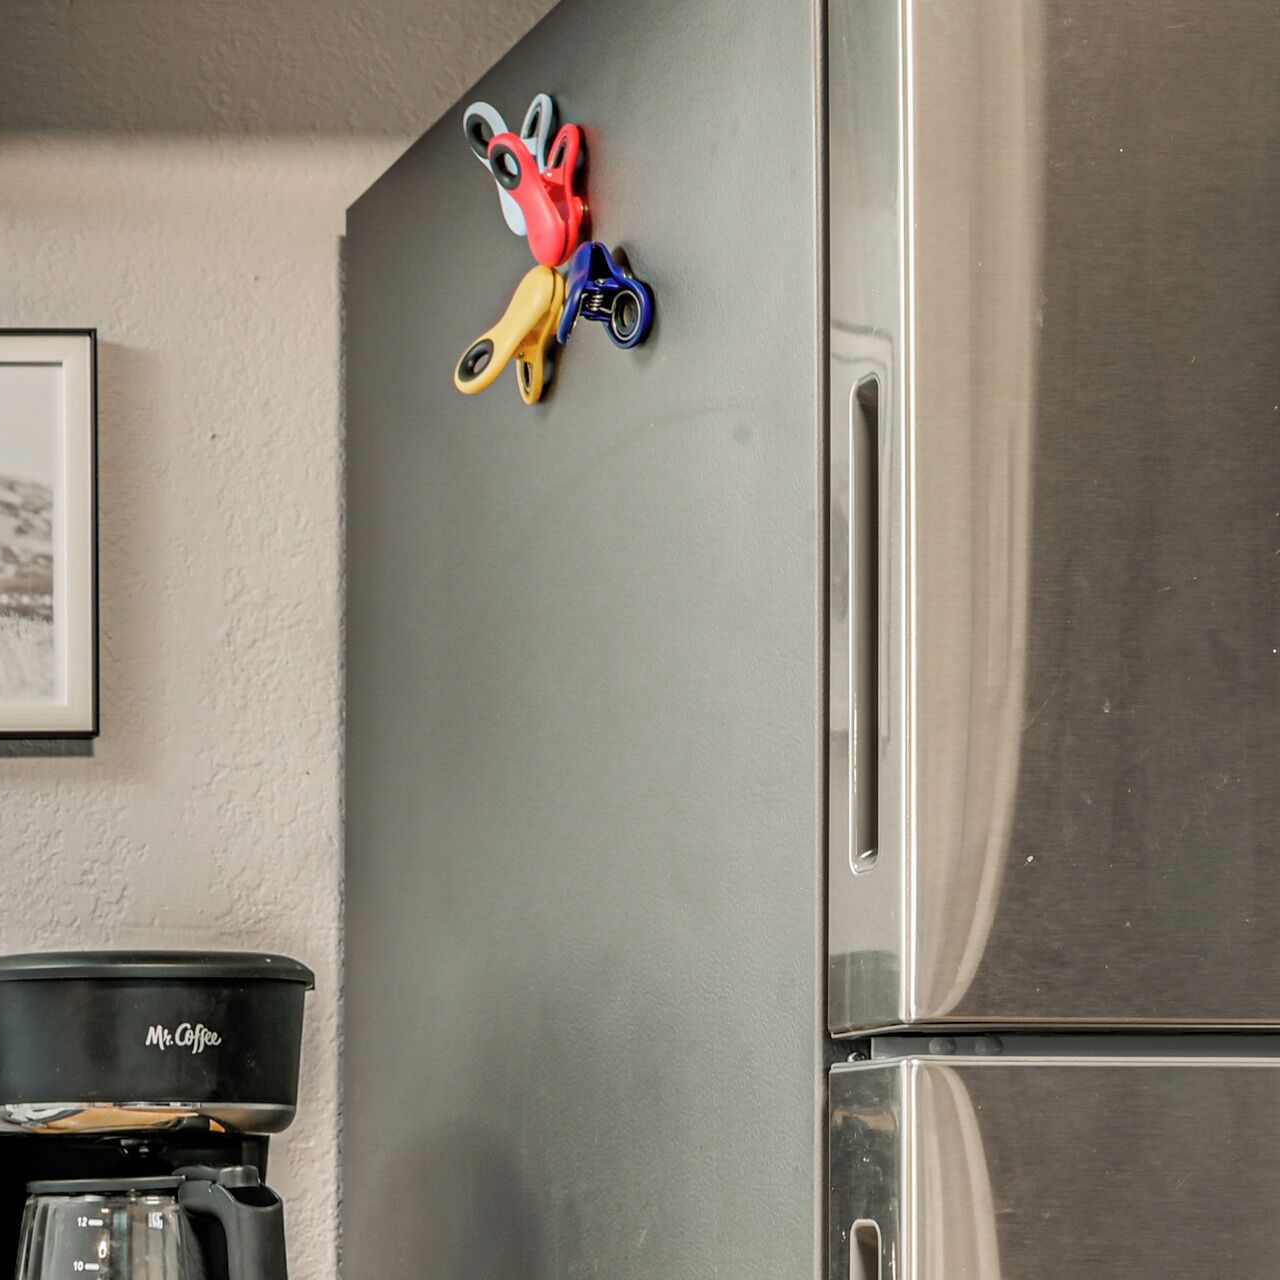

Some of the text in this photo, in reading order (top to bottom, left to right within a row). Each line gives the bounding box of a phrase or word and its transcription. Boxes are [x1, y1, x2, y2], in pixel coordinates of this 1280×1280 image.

[145, 1022, 222, 1055] Mr. Coffee
[77, 1217, 88, 1227] 12
[73, 1261, 84, 1271] 10
